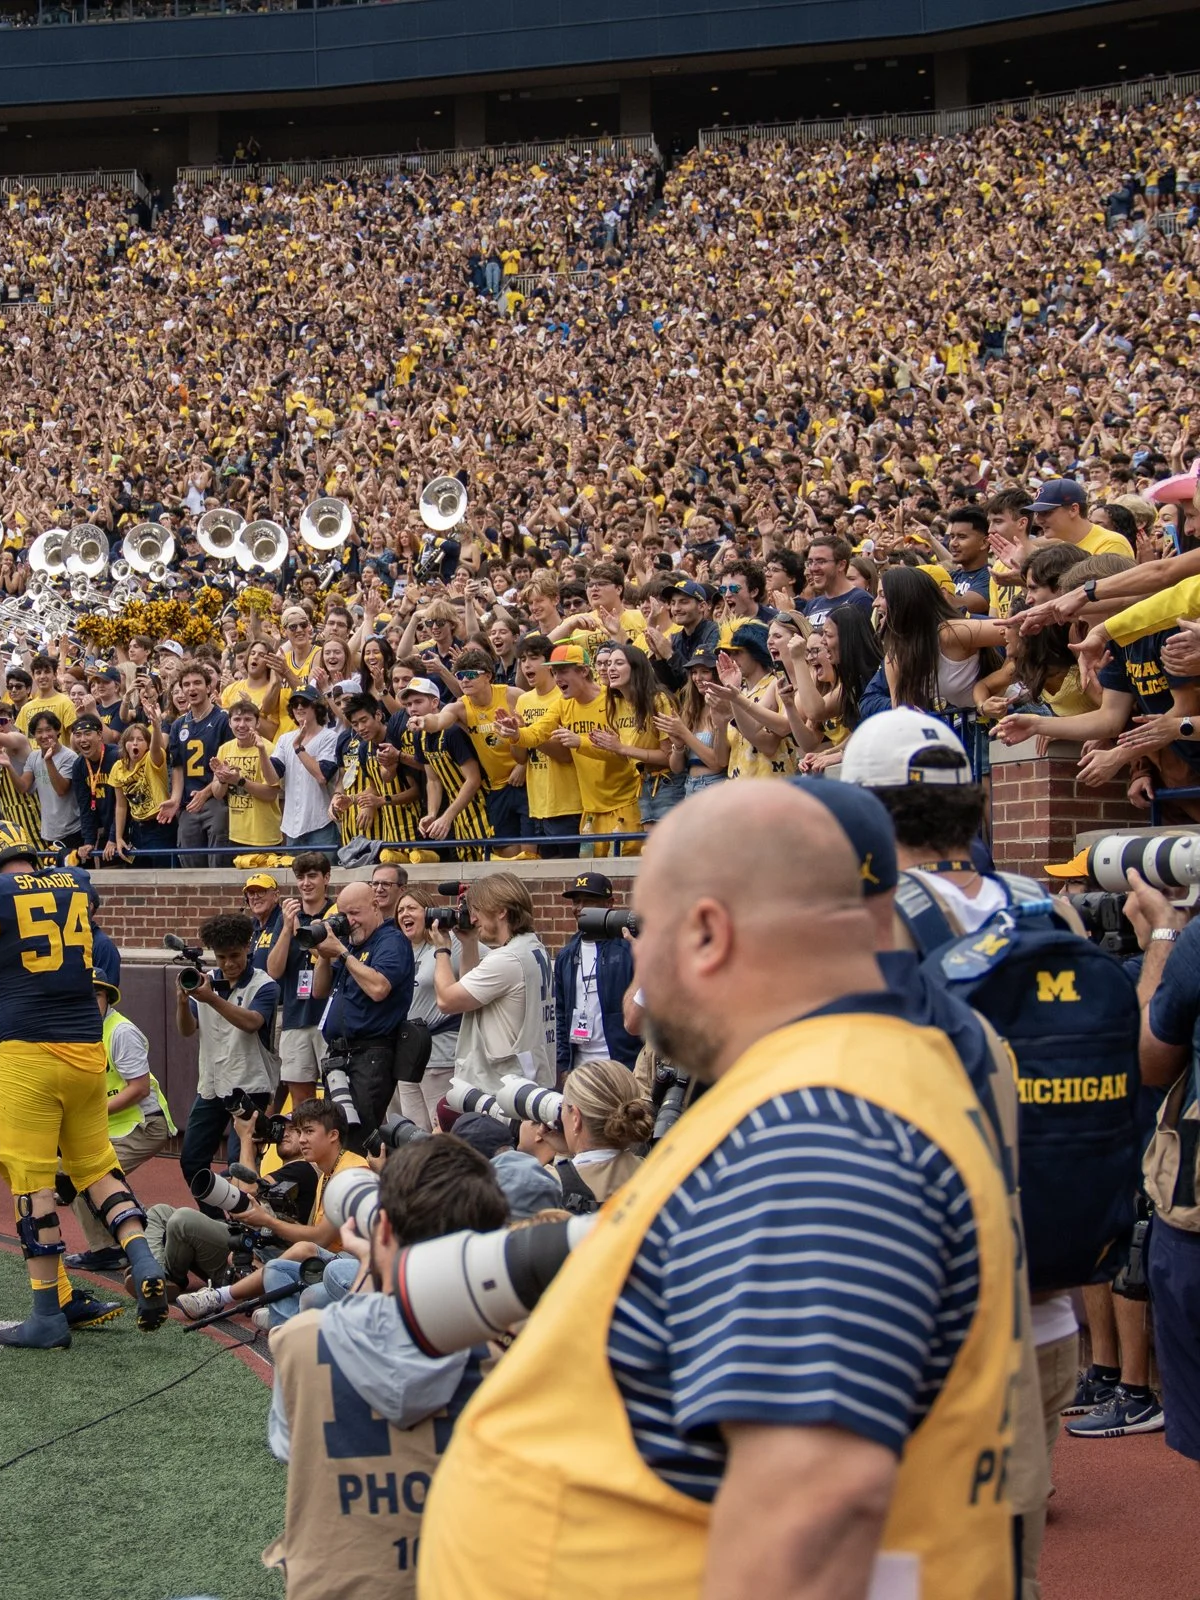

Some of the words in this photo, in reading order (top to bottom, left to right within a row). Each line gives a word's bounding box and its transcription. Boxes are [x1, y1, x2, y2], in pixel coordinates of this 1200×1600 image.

[187, 740, 204, 777] 2
[772, 761, 786, 773] M
[13, 873, 80, 890] SPRAGUE
[576, 877, 588, 887] M
[13, 892, 94, 973] 54
[359, 951, 369, 962] M
[1036, 970, 1081, 1001] M
